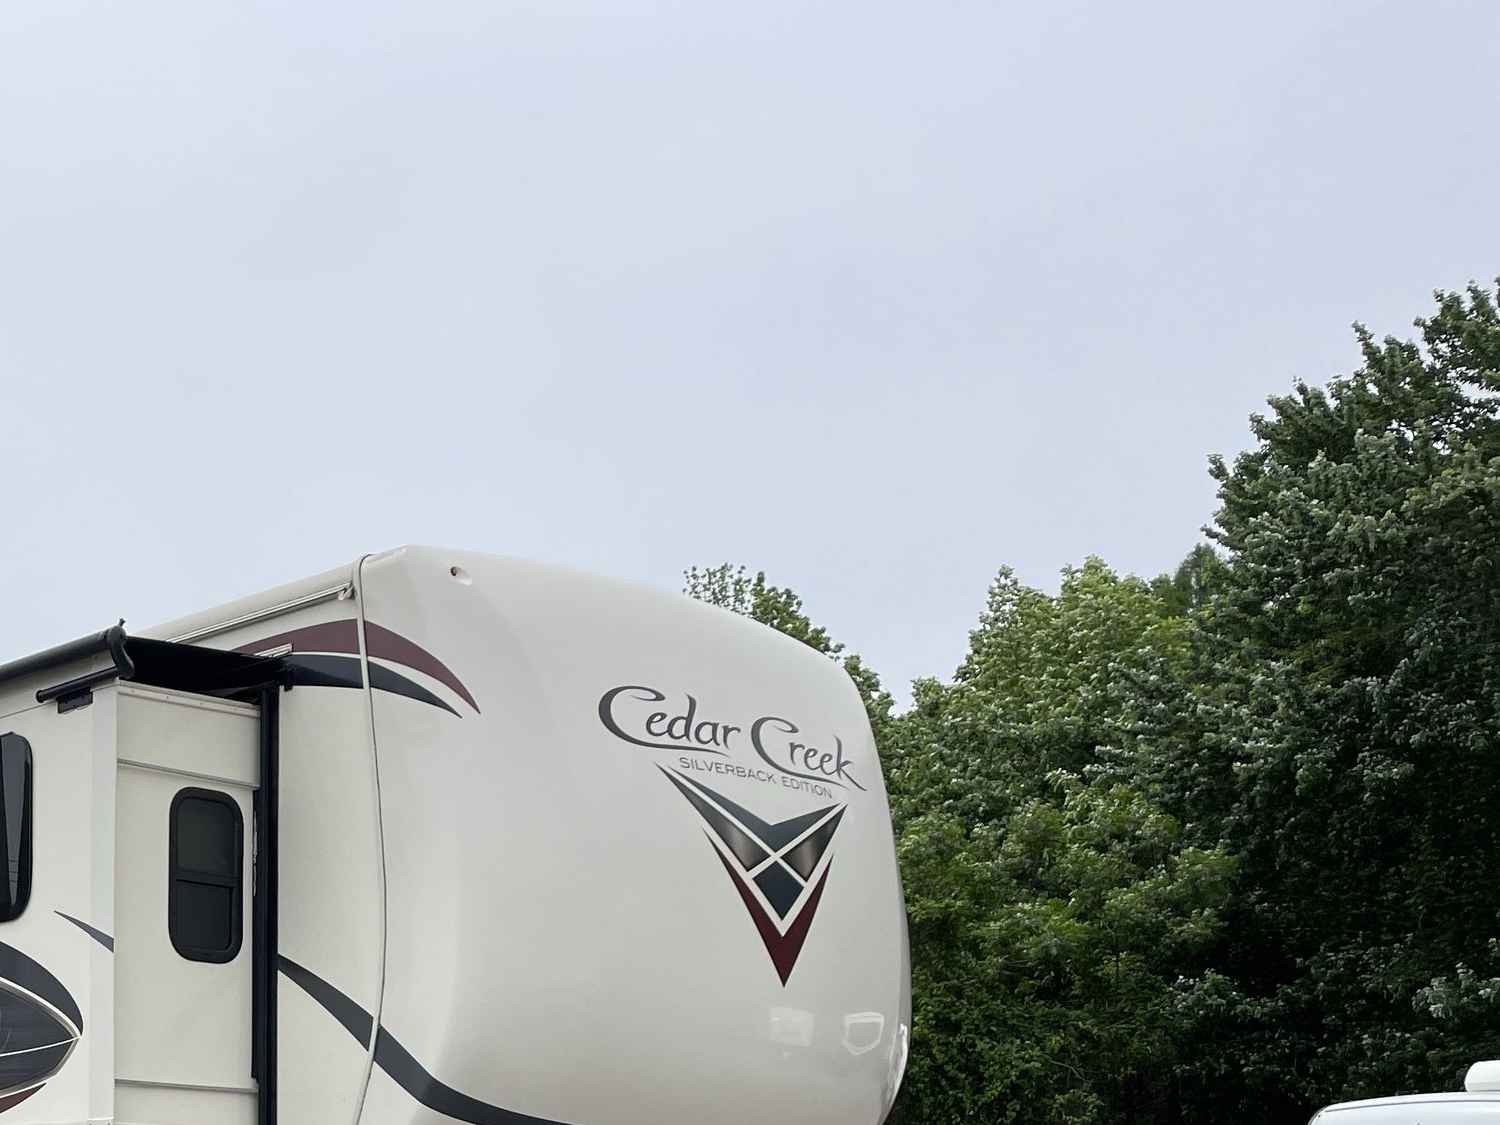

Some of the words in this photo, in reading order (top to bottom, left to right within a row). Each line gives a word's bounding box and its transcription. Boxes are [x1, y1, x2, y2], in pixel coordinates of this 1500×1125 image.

[598, 685, 742, 758] Cedar
[750, 716, 868, 792] Creek
[678, 756, 777, 785] SILVERBACK
[781, 775, 833, 800] EDITION
